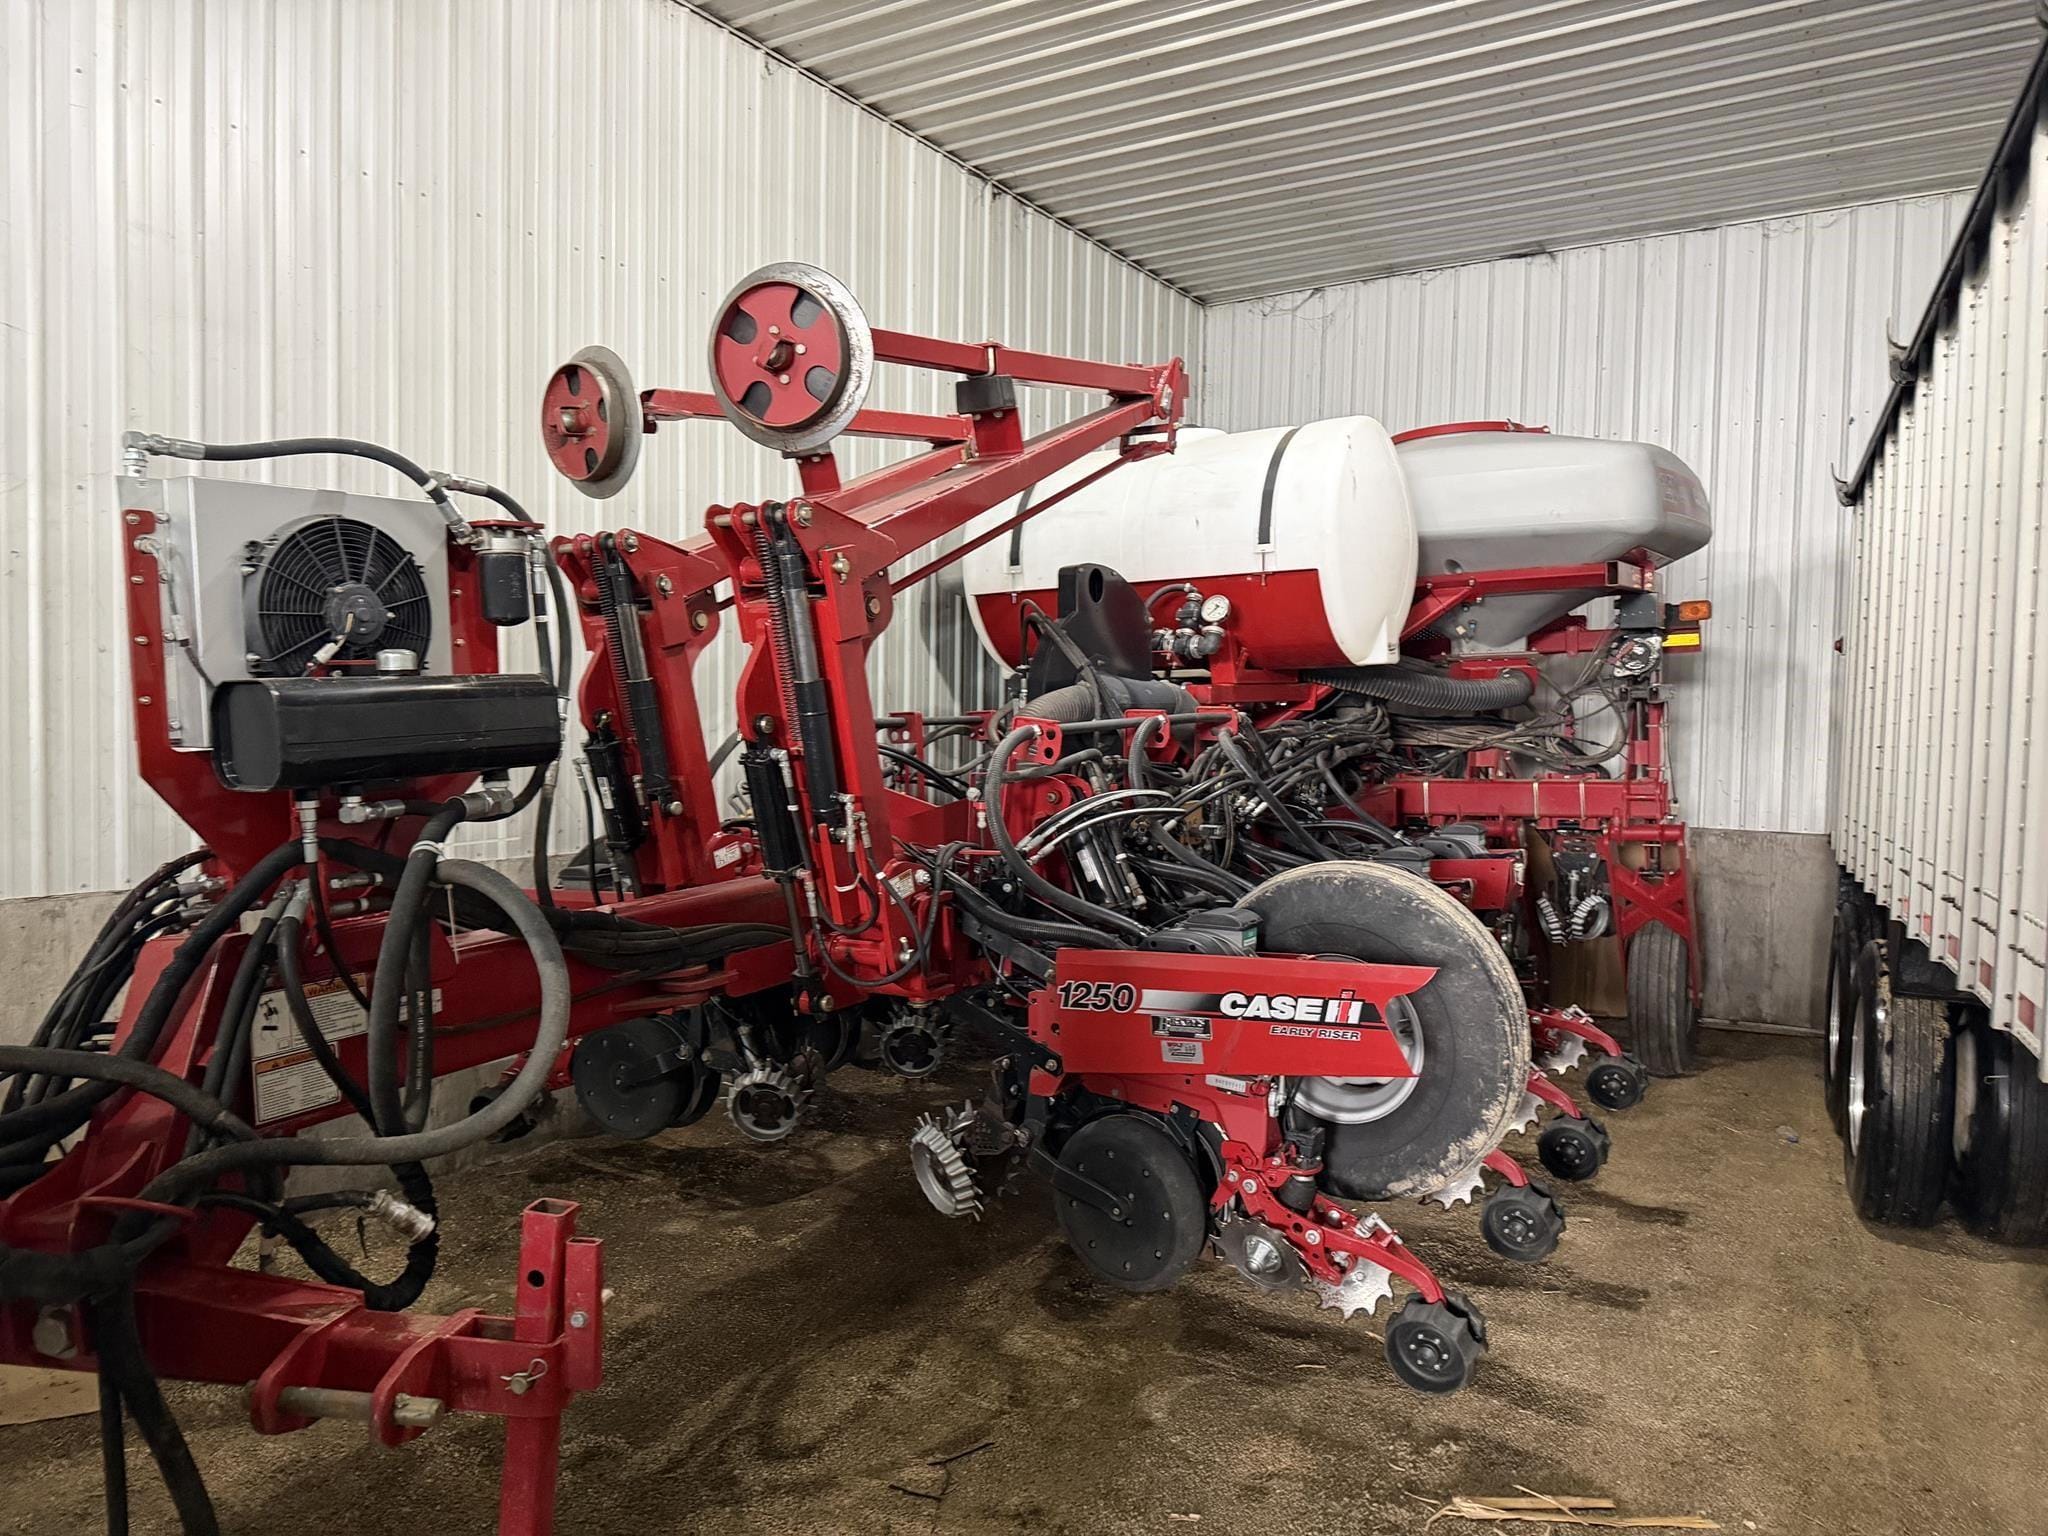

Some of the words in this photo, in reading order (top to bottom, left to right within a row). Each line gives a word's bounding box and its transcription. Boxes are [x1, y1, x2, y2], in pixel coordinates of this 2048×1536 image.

[1057, 980, 1137, 1014] 1250
[1219, 992, 1323, 1021] CASE
[1269, 1025, 1315, 1038] EARLY
[1317, 1029, 1361, 1041] RISER
